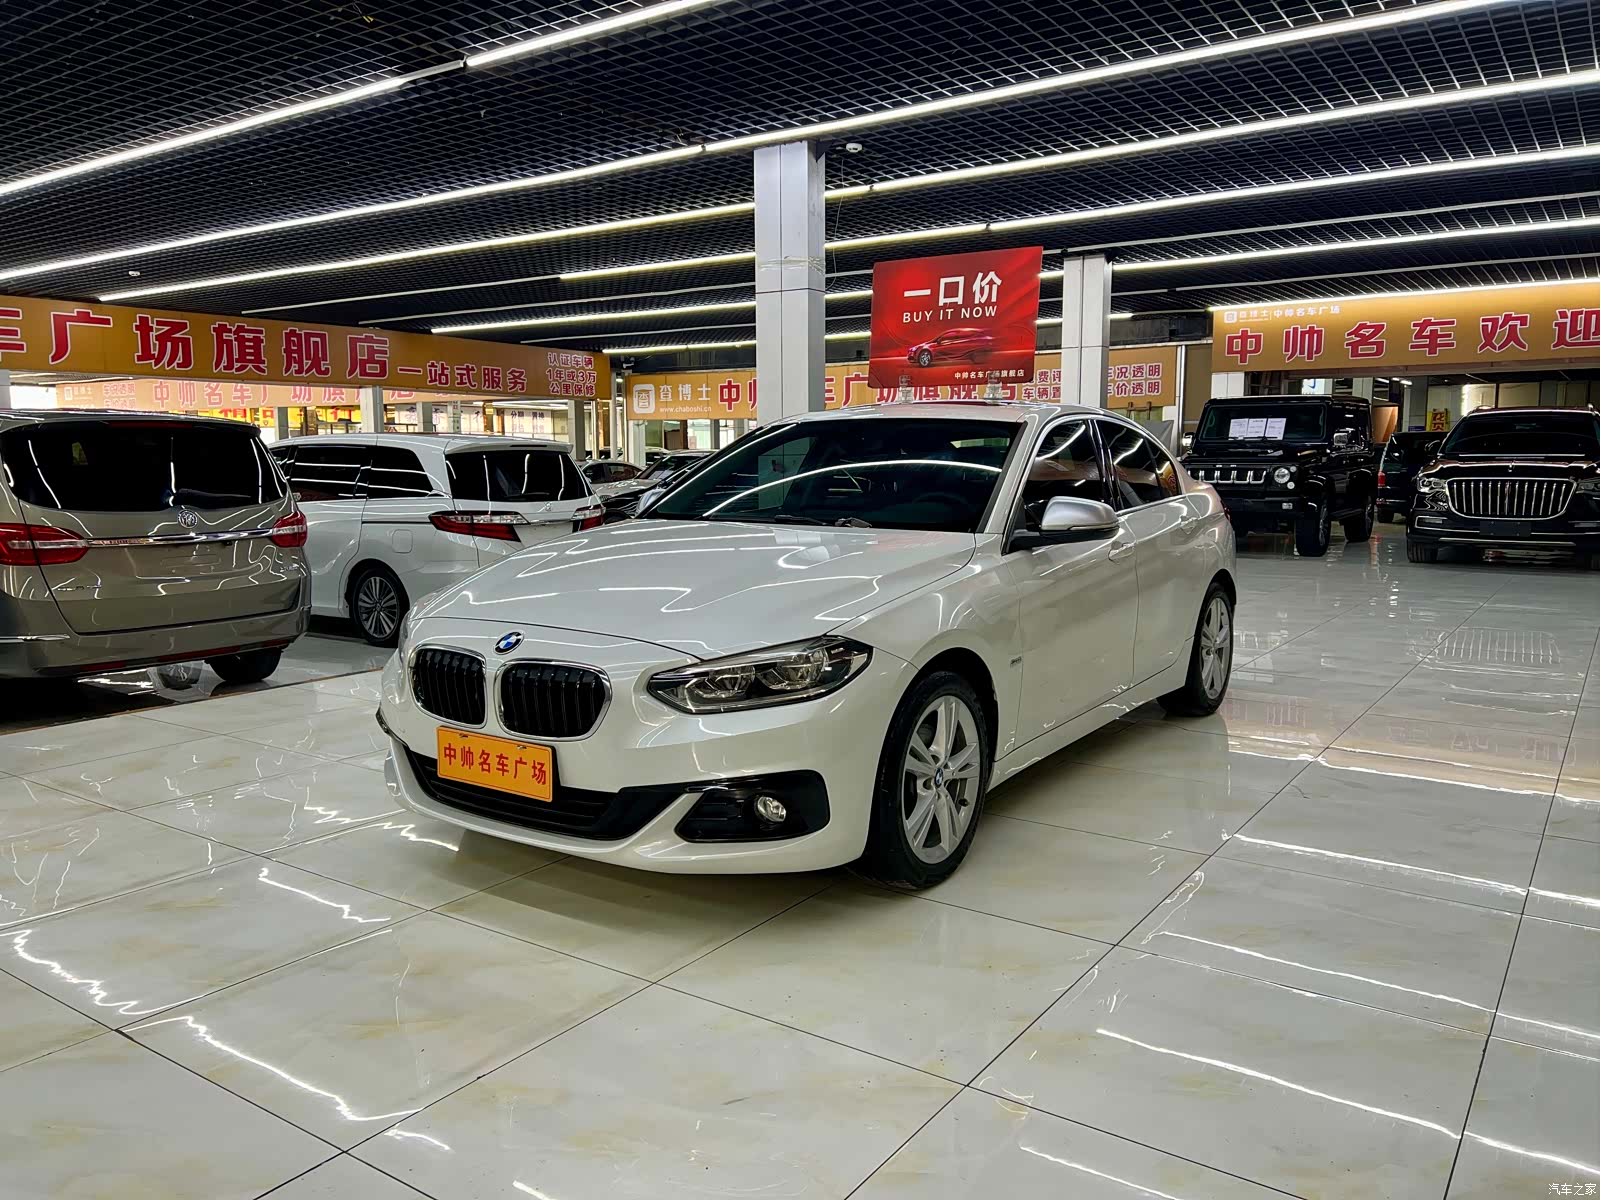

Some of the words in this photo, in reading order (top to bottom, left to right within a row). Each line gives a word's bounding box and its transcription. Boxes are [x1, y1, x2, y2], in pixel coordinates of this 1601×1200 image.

[903, 270, 1003, 307] 一口价
[902, 310, 933, 323] BUY
[939, 308, 954, 320] IT
[960, 305, 998, 319] NOW
[547, 351, 595, 369] 认证车辆
[397, 360, 528, 393] 一站式服务
[546, 368, 597, 384] 1年或3万
[549, 382, 596, 397] 公里保修
[659, 383, 712, 402] 查博士
[659, 405, 712, 414] www.chaboshi.cn
[443, 742, 547, 785] 中帅名车广场
